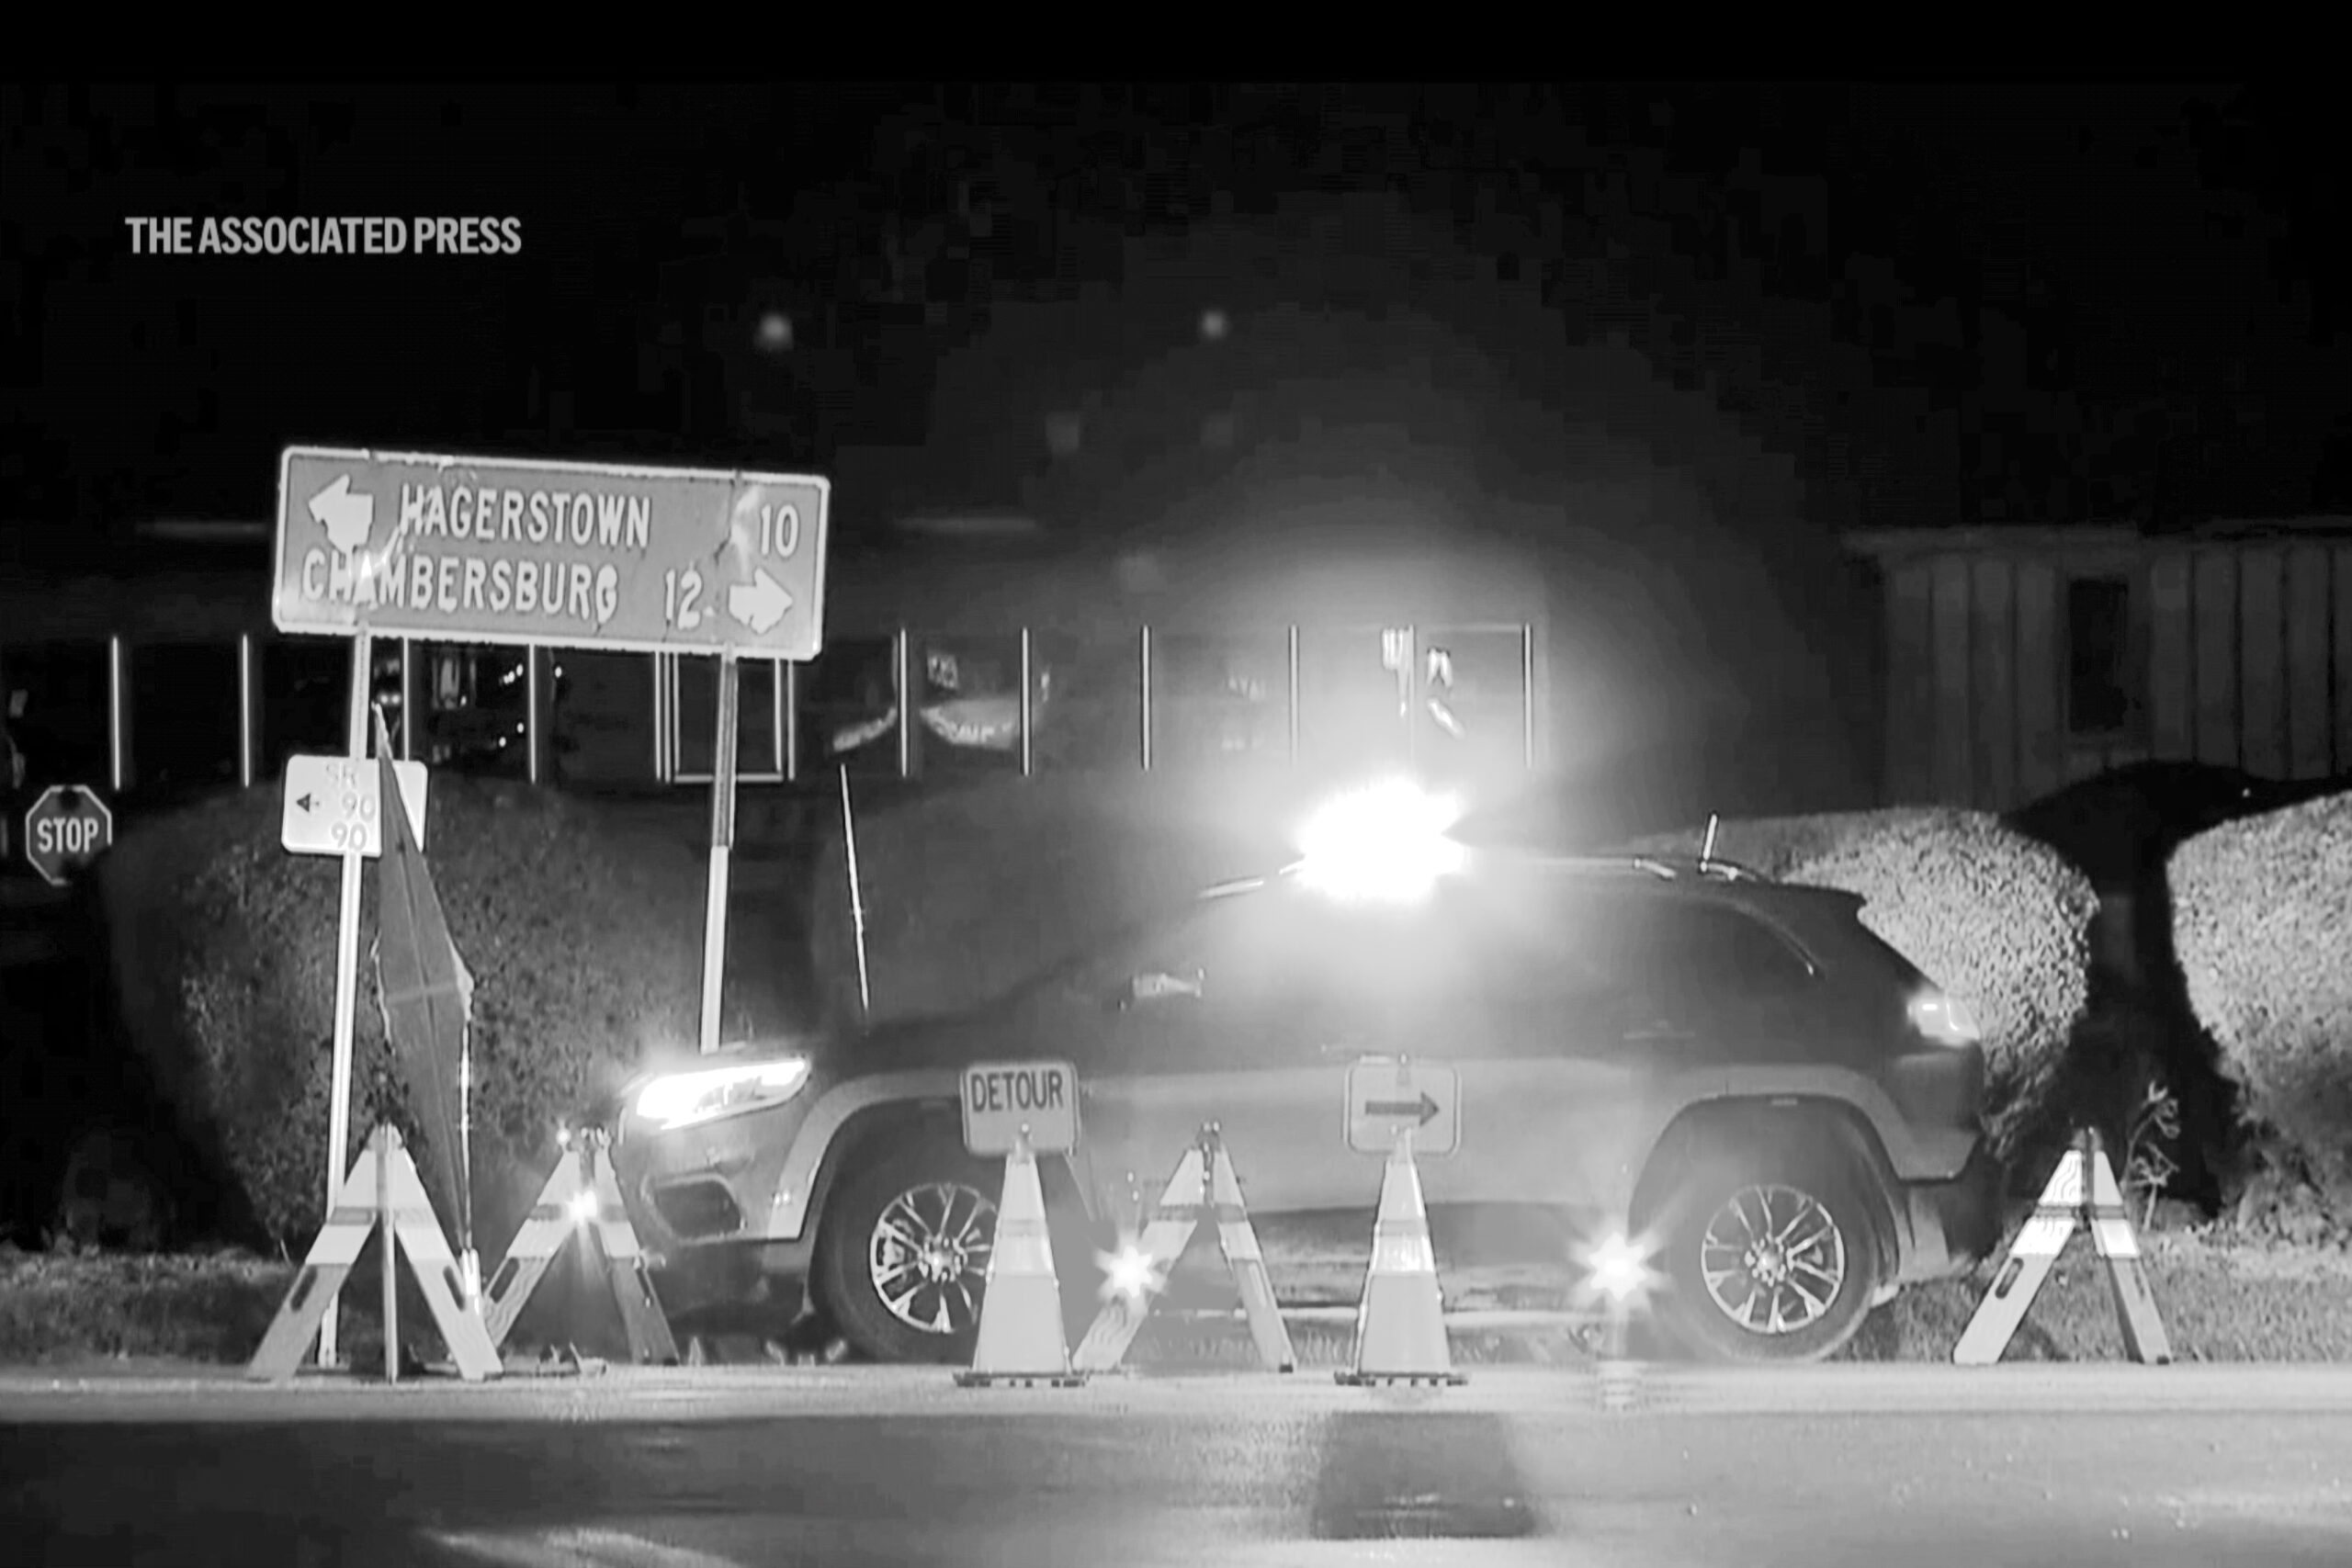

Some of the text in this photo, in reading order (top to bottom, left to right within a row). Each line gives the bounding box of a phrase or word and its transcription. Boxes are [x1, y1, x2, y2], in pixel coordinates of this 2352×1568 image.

[399, 482, 800, 558] HAGERSTOWN 10
[302, 548, 704, 629] CHAMBERSBURG 12
[38, 817, 98, 854] STOP
[970, 1069, 1064, 1112] DETOUR
